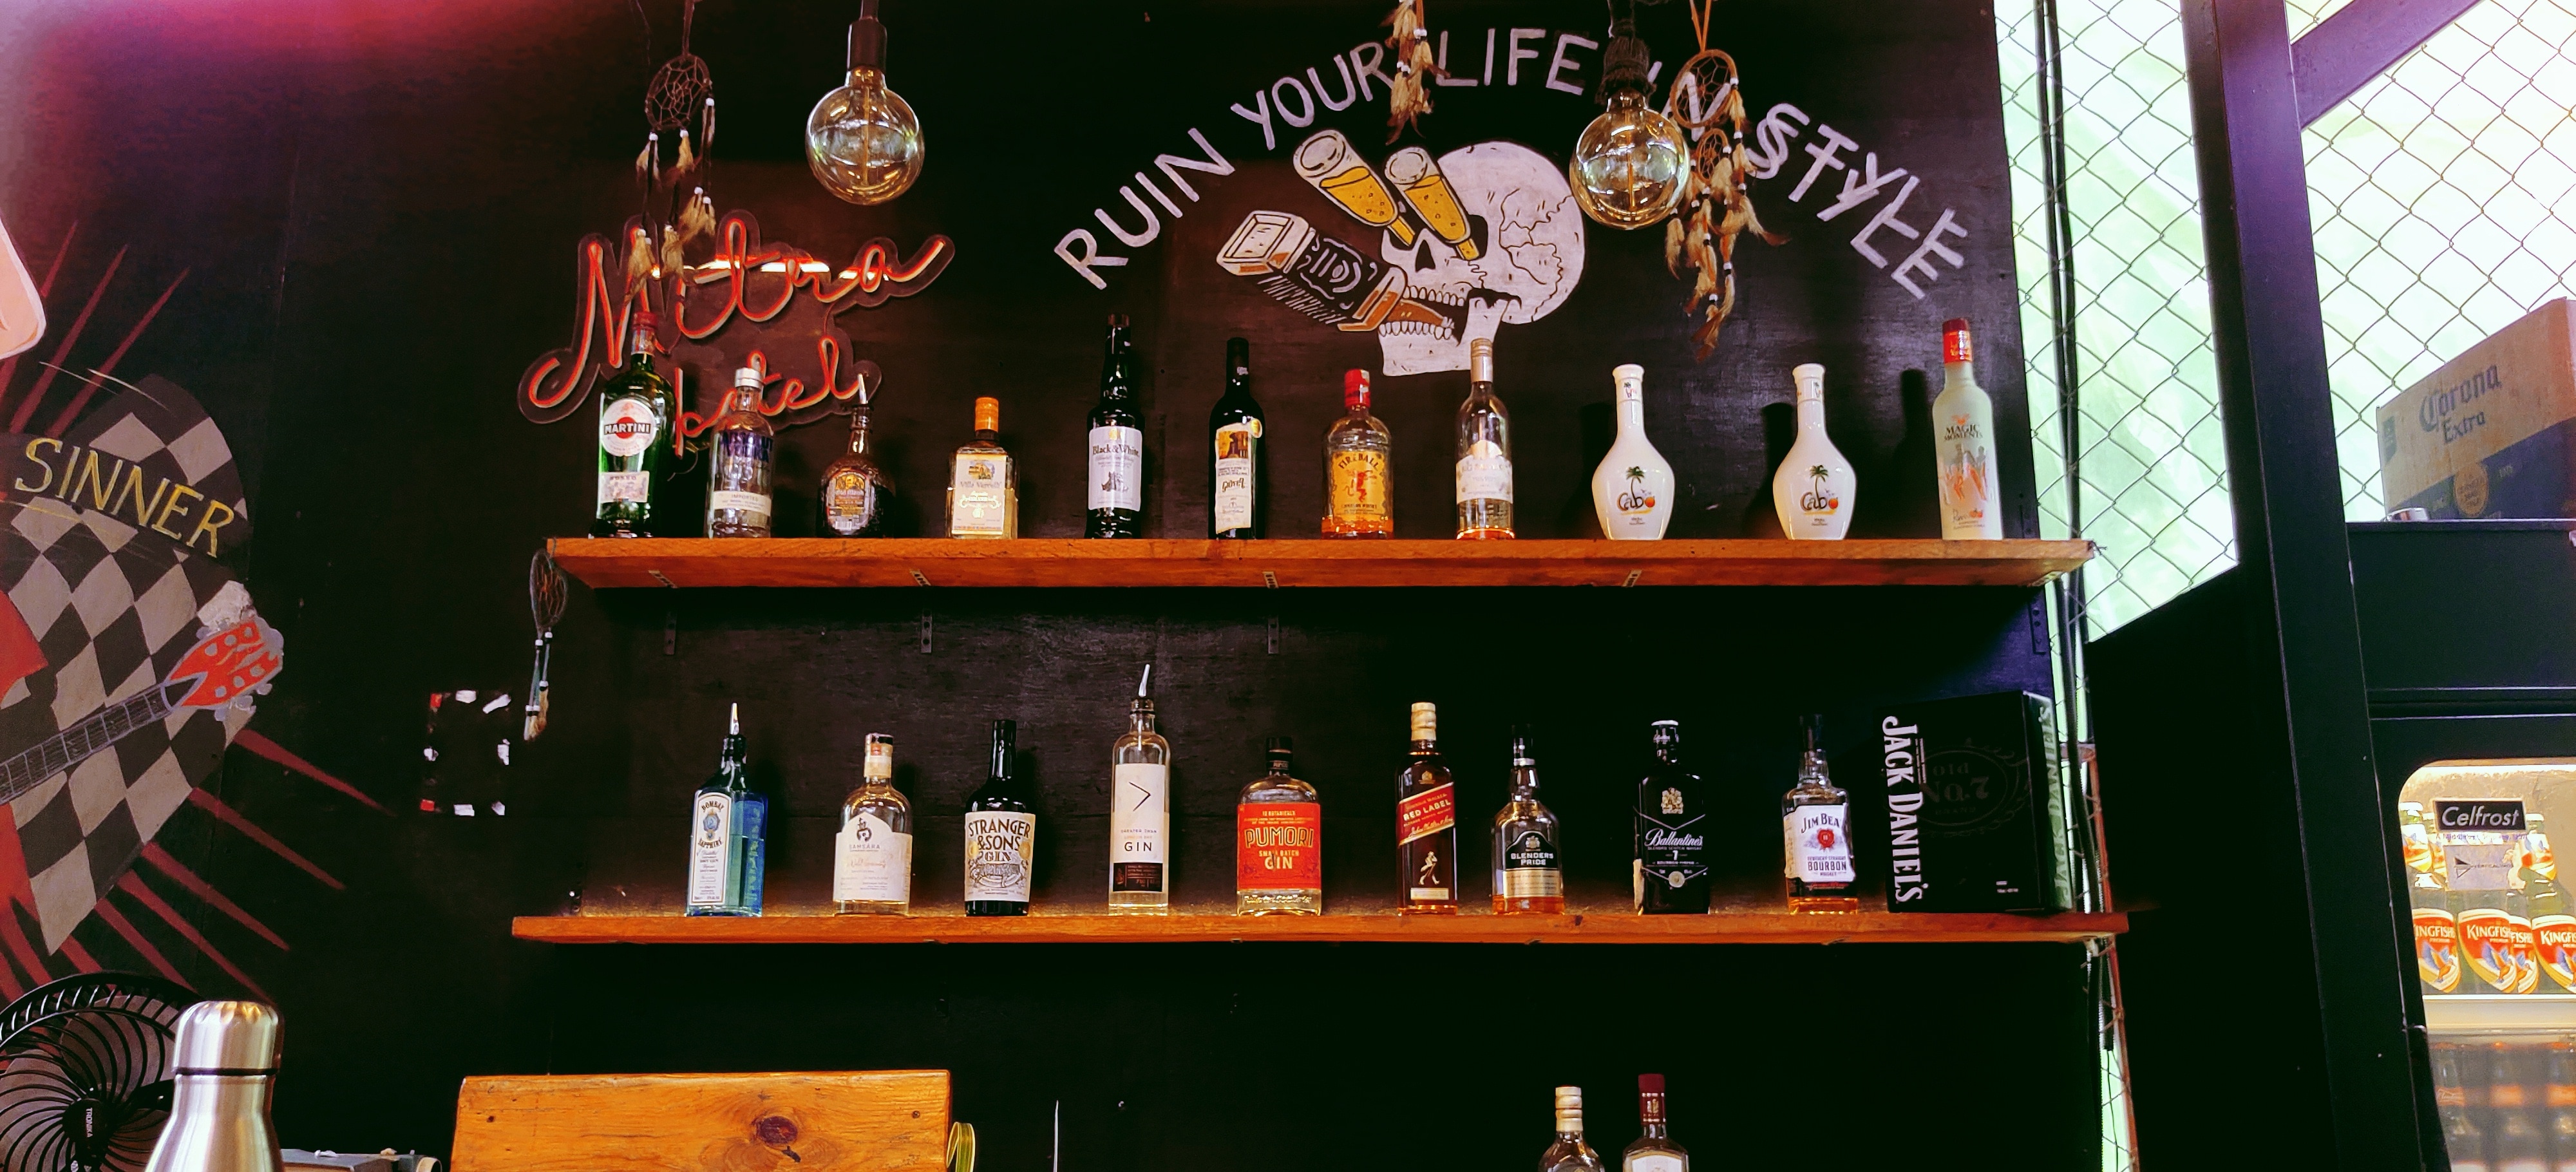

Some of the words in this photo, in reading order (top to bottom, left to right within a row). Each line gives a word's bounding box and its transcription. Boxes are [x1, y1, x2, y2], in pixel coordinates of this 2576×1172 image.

[1054, 128, 1235, 290] RUIN
[1231, 41, 1394, 150] YOUR
[1435, 28, 1598, 95] LIFE
[1745, 103, 1969, 299] STYLE
[2418, 363, 2502, 433] Corona
[605, 422, 650, 434] MARTINI
[1946, 424, 1980, 434] MAGIC
[2443, 410, 2486, 443] Extra
[1338, 453, 1379, 471] FIREBALL
[15, 437, 236, 557] SINNER
[1882, 715, 1918, 787] JACK
[701, 801, 724, 813] BOMBAY
[1403, 809, 1421, 821] RED
[1423, 799, 1451, 813] LABEL
[2441, 806, 2519, 826] Celfrost
[968, 819, 1031, 838] STRANGER
[1801, 816, 1819, 834] JIM
[1821, 813, 1841, 827] BEA
[1124, 842, 1152, 852] GIN
[1244, 826, 1314, 848] PUMORI
[1644, 827, 1703, 847] Ballantine's
[985, 851, 1012, 862] GIN
[1888, 792, 1929, 903] DANIEL'S
[1264, 856, 1293, 870] GIN
[1808, 861, 1847, 871] BOURBON
